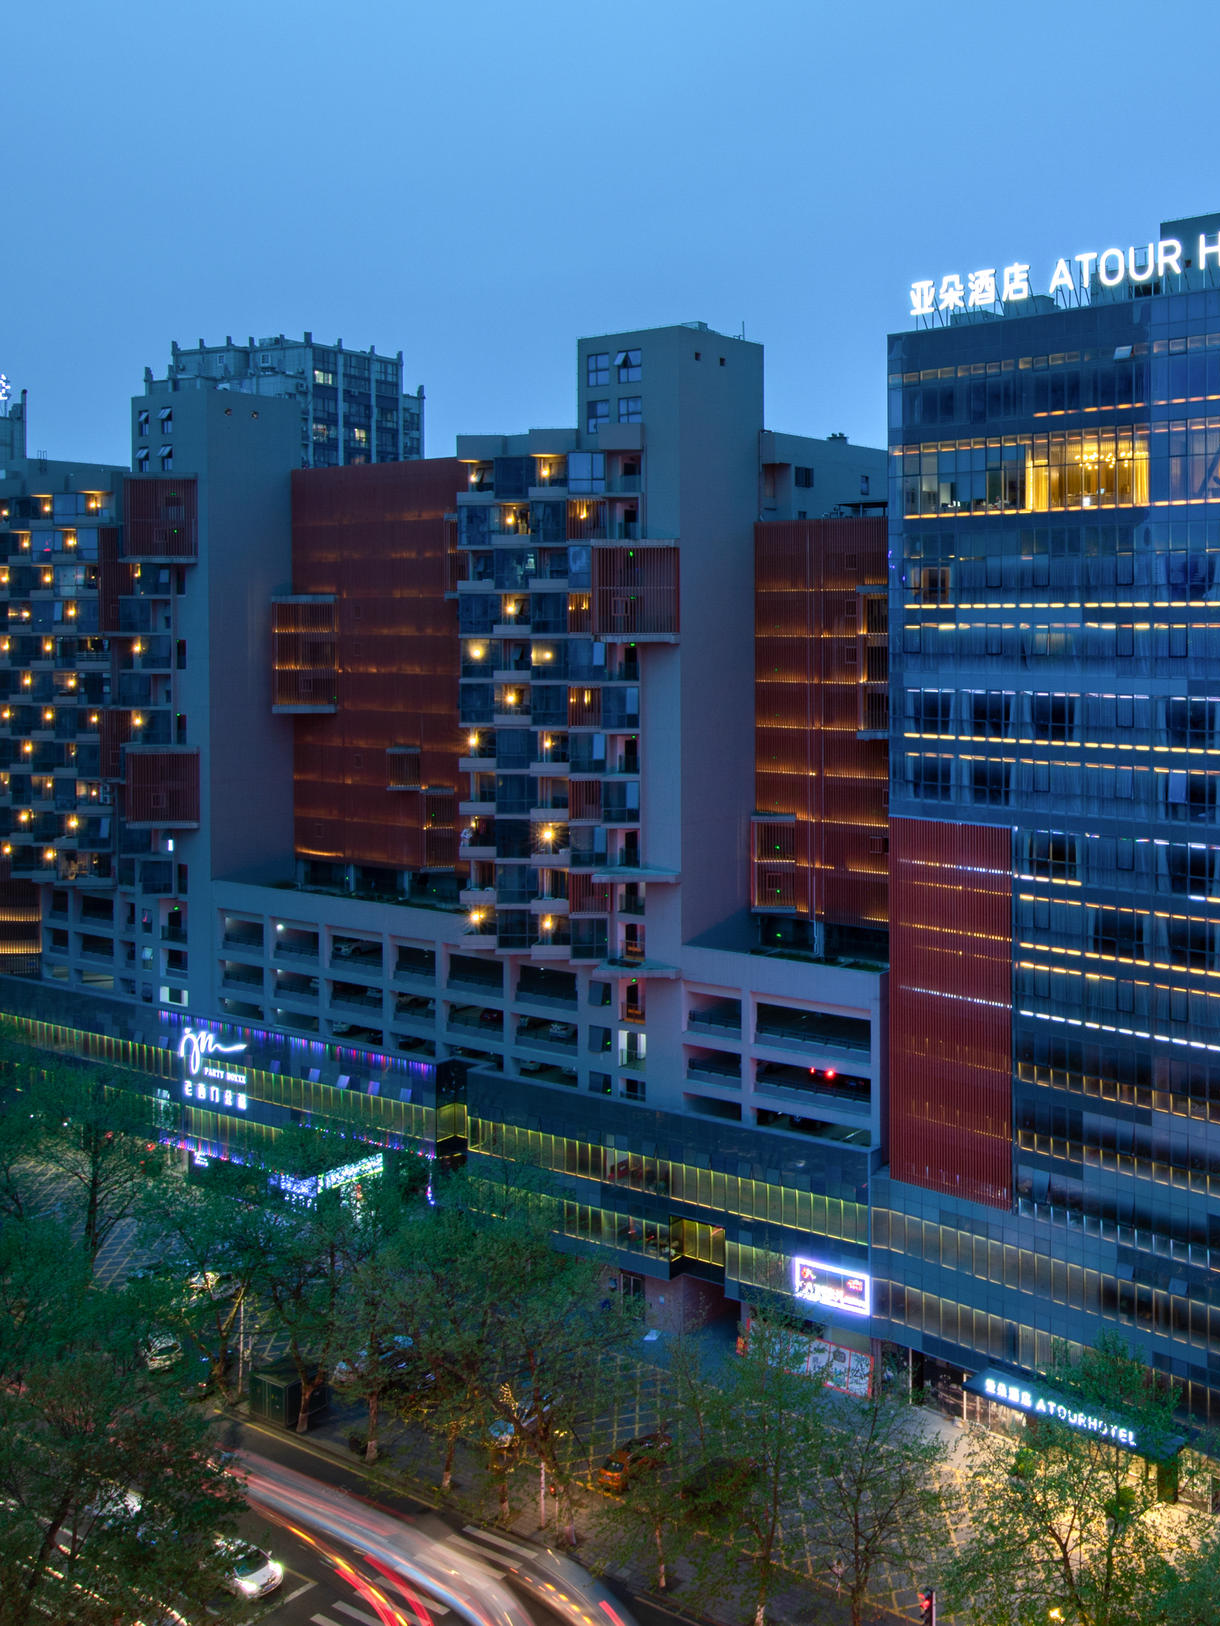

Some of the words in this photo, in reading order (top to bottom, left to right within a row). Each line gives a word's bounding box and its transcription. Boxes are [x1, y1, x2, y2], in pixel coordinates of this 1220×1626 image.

[910, 262, 1031, 315] 亚朵酒店
[1049, 239, 1182, 294] ATOUR
